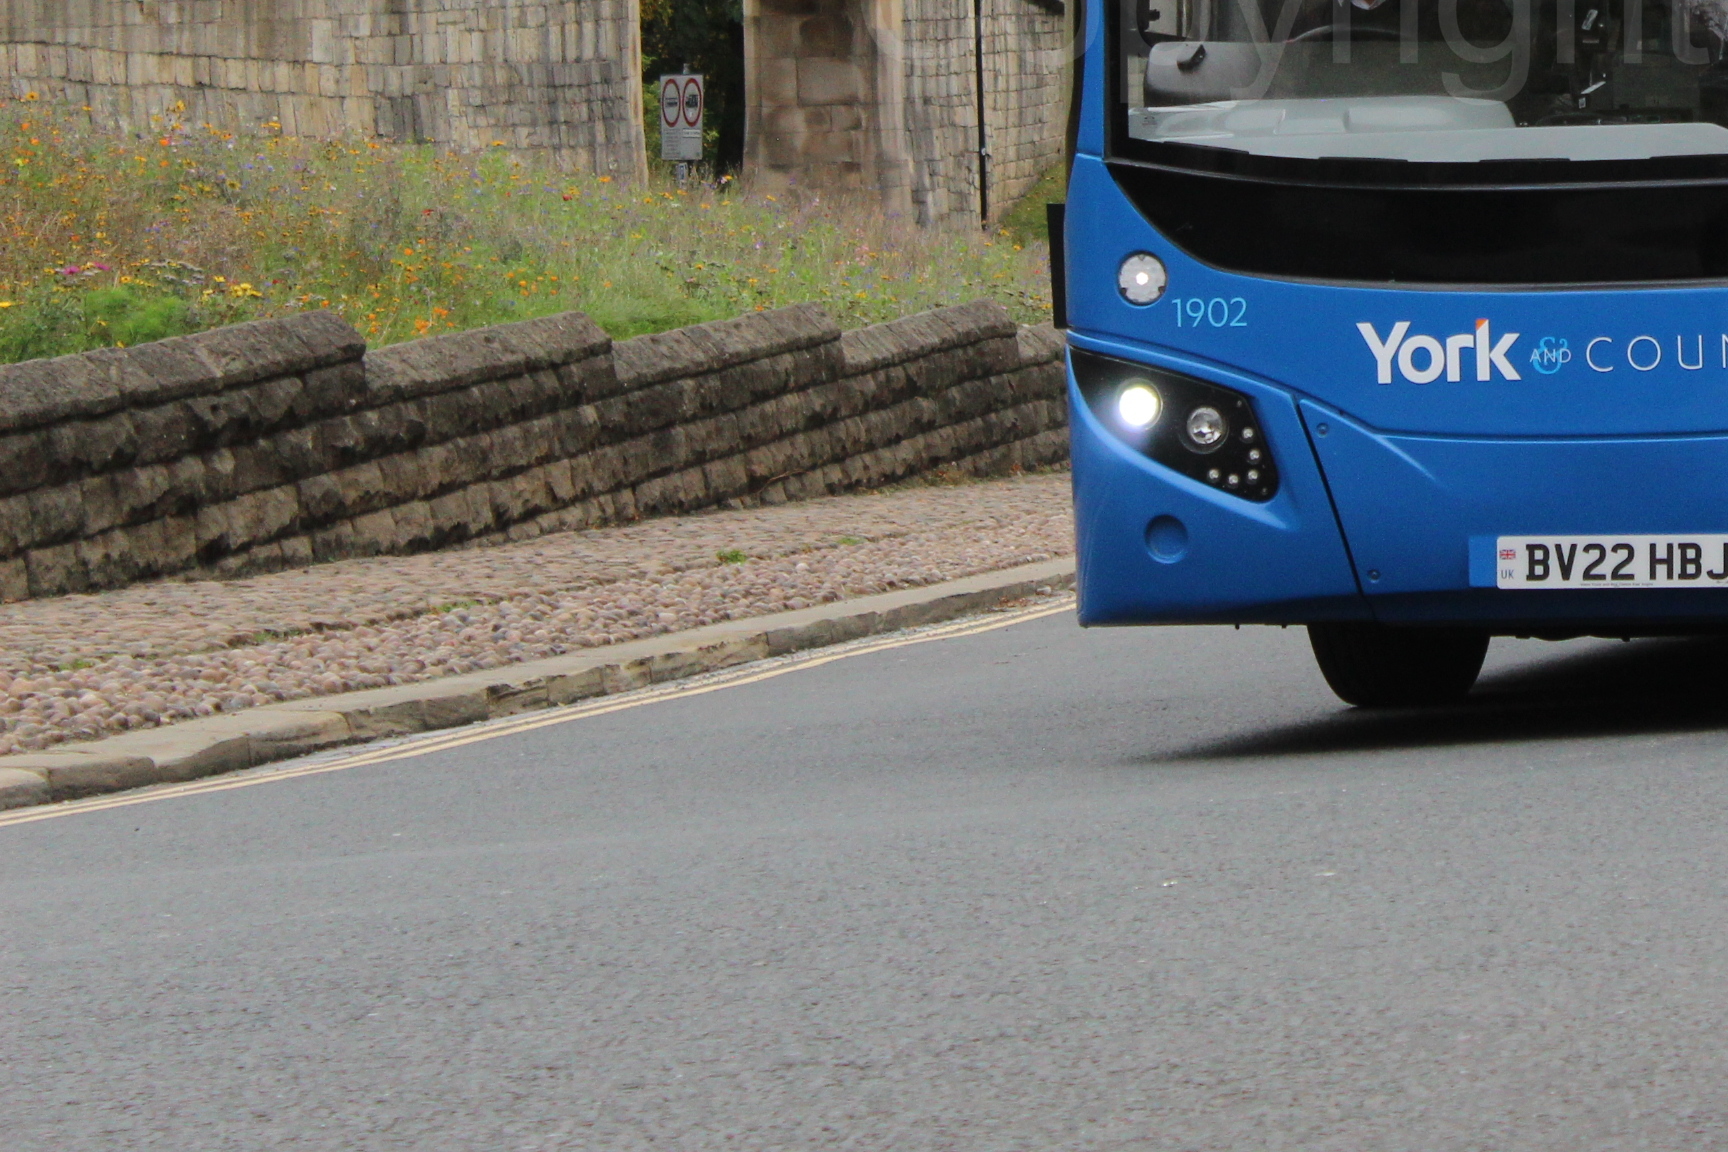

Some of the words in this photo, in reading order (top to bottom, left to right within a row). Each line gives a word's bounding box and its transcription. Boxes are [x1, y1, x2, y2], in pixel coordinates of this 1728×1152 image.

[1172, 297, 1248, 328] 1902
[1356, 319, 1521, 384] York
[1529, 348, 1572, 364] AND
[1501, 569, 1515, 579] UK
[1525, 543, 1636, 581] BV22
